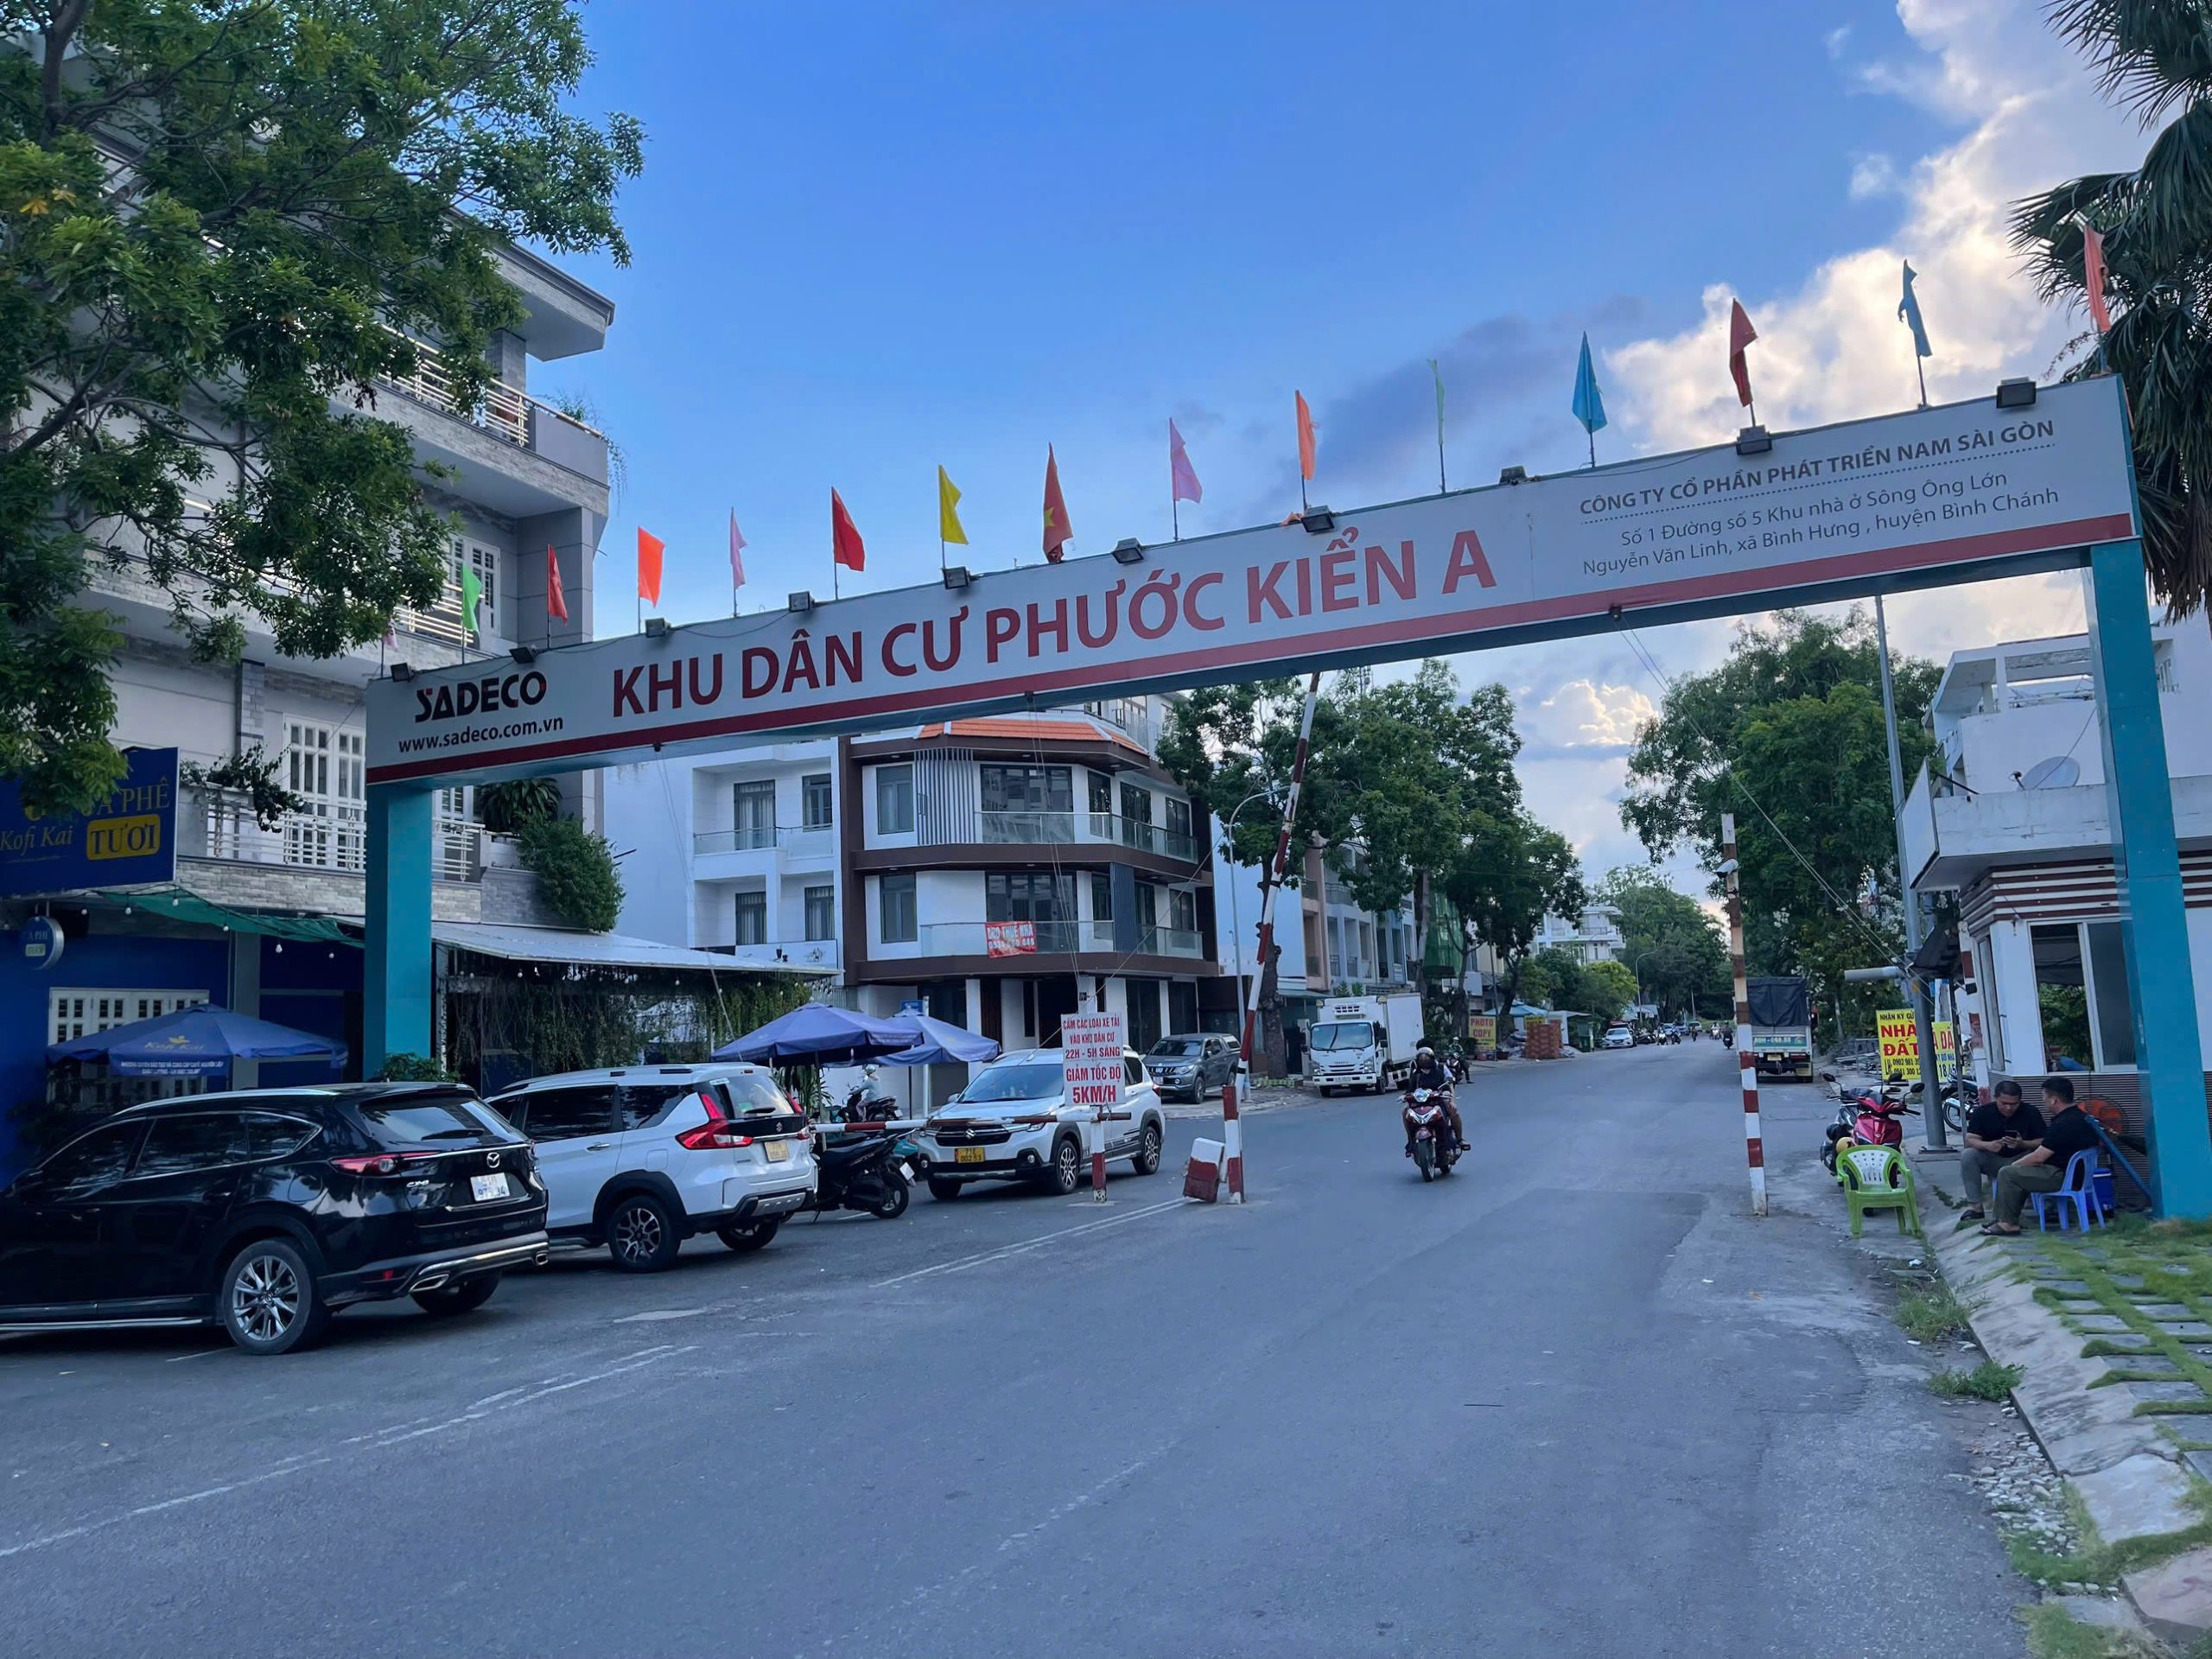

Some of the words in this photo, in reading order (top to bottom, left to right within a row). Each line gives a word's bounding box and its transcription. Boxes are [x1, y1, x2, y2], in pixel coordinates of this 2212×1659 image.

[1580, 492, 1637, 515] CÔNG
[1639, 486, 1665, 505] TY
[1669, 476, 1699, 500] CỔ
[1703, 468, 1762, 495] PHẦN
[1767, 460, 1823, 485] PHÁT
[1827, 444, 1891, 474] TRIỂN
[1897, 438, 1951, 461] NAM
[1957, 429, 1994, 452] SÀI
[2000, 419, 2055, 442] GÒN
[1621, 527, 1643, 547] Số
[1648, 528, 1656, 542] 1
[1661, 520, 1723, 540] Đường
[1726, 511, 1747, 530] số
[1751, 511, 1763, 525] 5
[1767, 505, 1804, 524] Khu
[1808, 497, 1845, 517] nhà
[1849, 493, 1863, 510] ở
[1866, 486, 1917, 508] Sông
[1921, 478, 1965, 498] Ông
[1969, 470, 2008, 491] Lớn
[1583, 550, 1649, 577] Nguyễn
[1652, 547, 1686, 565] Văn
[1690, 539, 1733, 560] Linh,
[1737, 534, 1758, 552] xã
[1762, 527, 1803, 549] Bình
[1808, 520, 1861, 542] Hưng
[1875, 508, 1936, 531] huyện
[1942, 500, 1986, 520] Bình
[1992, 486, 2059, 512] Chánh
[613, 652, 723, 718] KHU
[741, 627, 863, 700] DÂN
[880, 604, 969, 677] CƯ
[986, 568, 1225, 664] PHƯỚC
[1247, 525, 1420, 625] KIỂN
[1440, 529, 1498, 595] A
[415, 671, 548, 724] SADECO
[398, 716, 564, 754] www.sadeco.com.vn
[121, 776, 171, 813] PHÊ
[0, 825, 37, 857] Kofi
[41, 824, 74, 848] Kai
[90, 823, 157, 855] TƯƠI
[1103, 1017, 1110, 1027] XE
[1471, 1018, 1494, 1027] PHOTO
[1473, 1028, 1492, 1038] COPY
[1880, 1020, 1917, 1038] NHÀ
[1065, 1049, 1080, 1059] 22H
[1087, 1048, 1097, 1058] 5H
[1883, 1037, 1920, 1057] ĐẤT
[1066, 1064, 1089, 1082] GIẢM
[1090, 1062, 1107, 1081] TỐC
[1109, 1063, 1122, 1083] ĐỘ
[1072, 1084, 1117, 1104] 5KM/H
